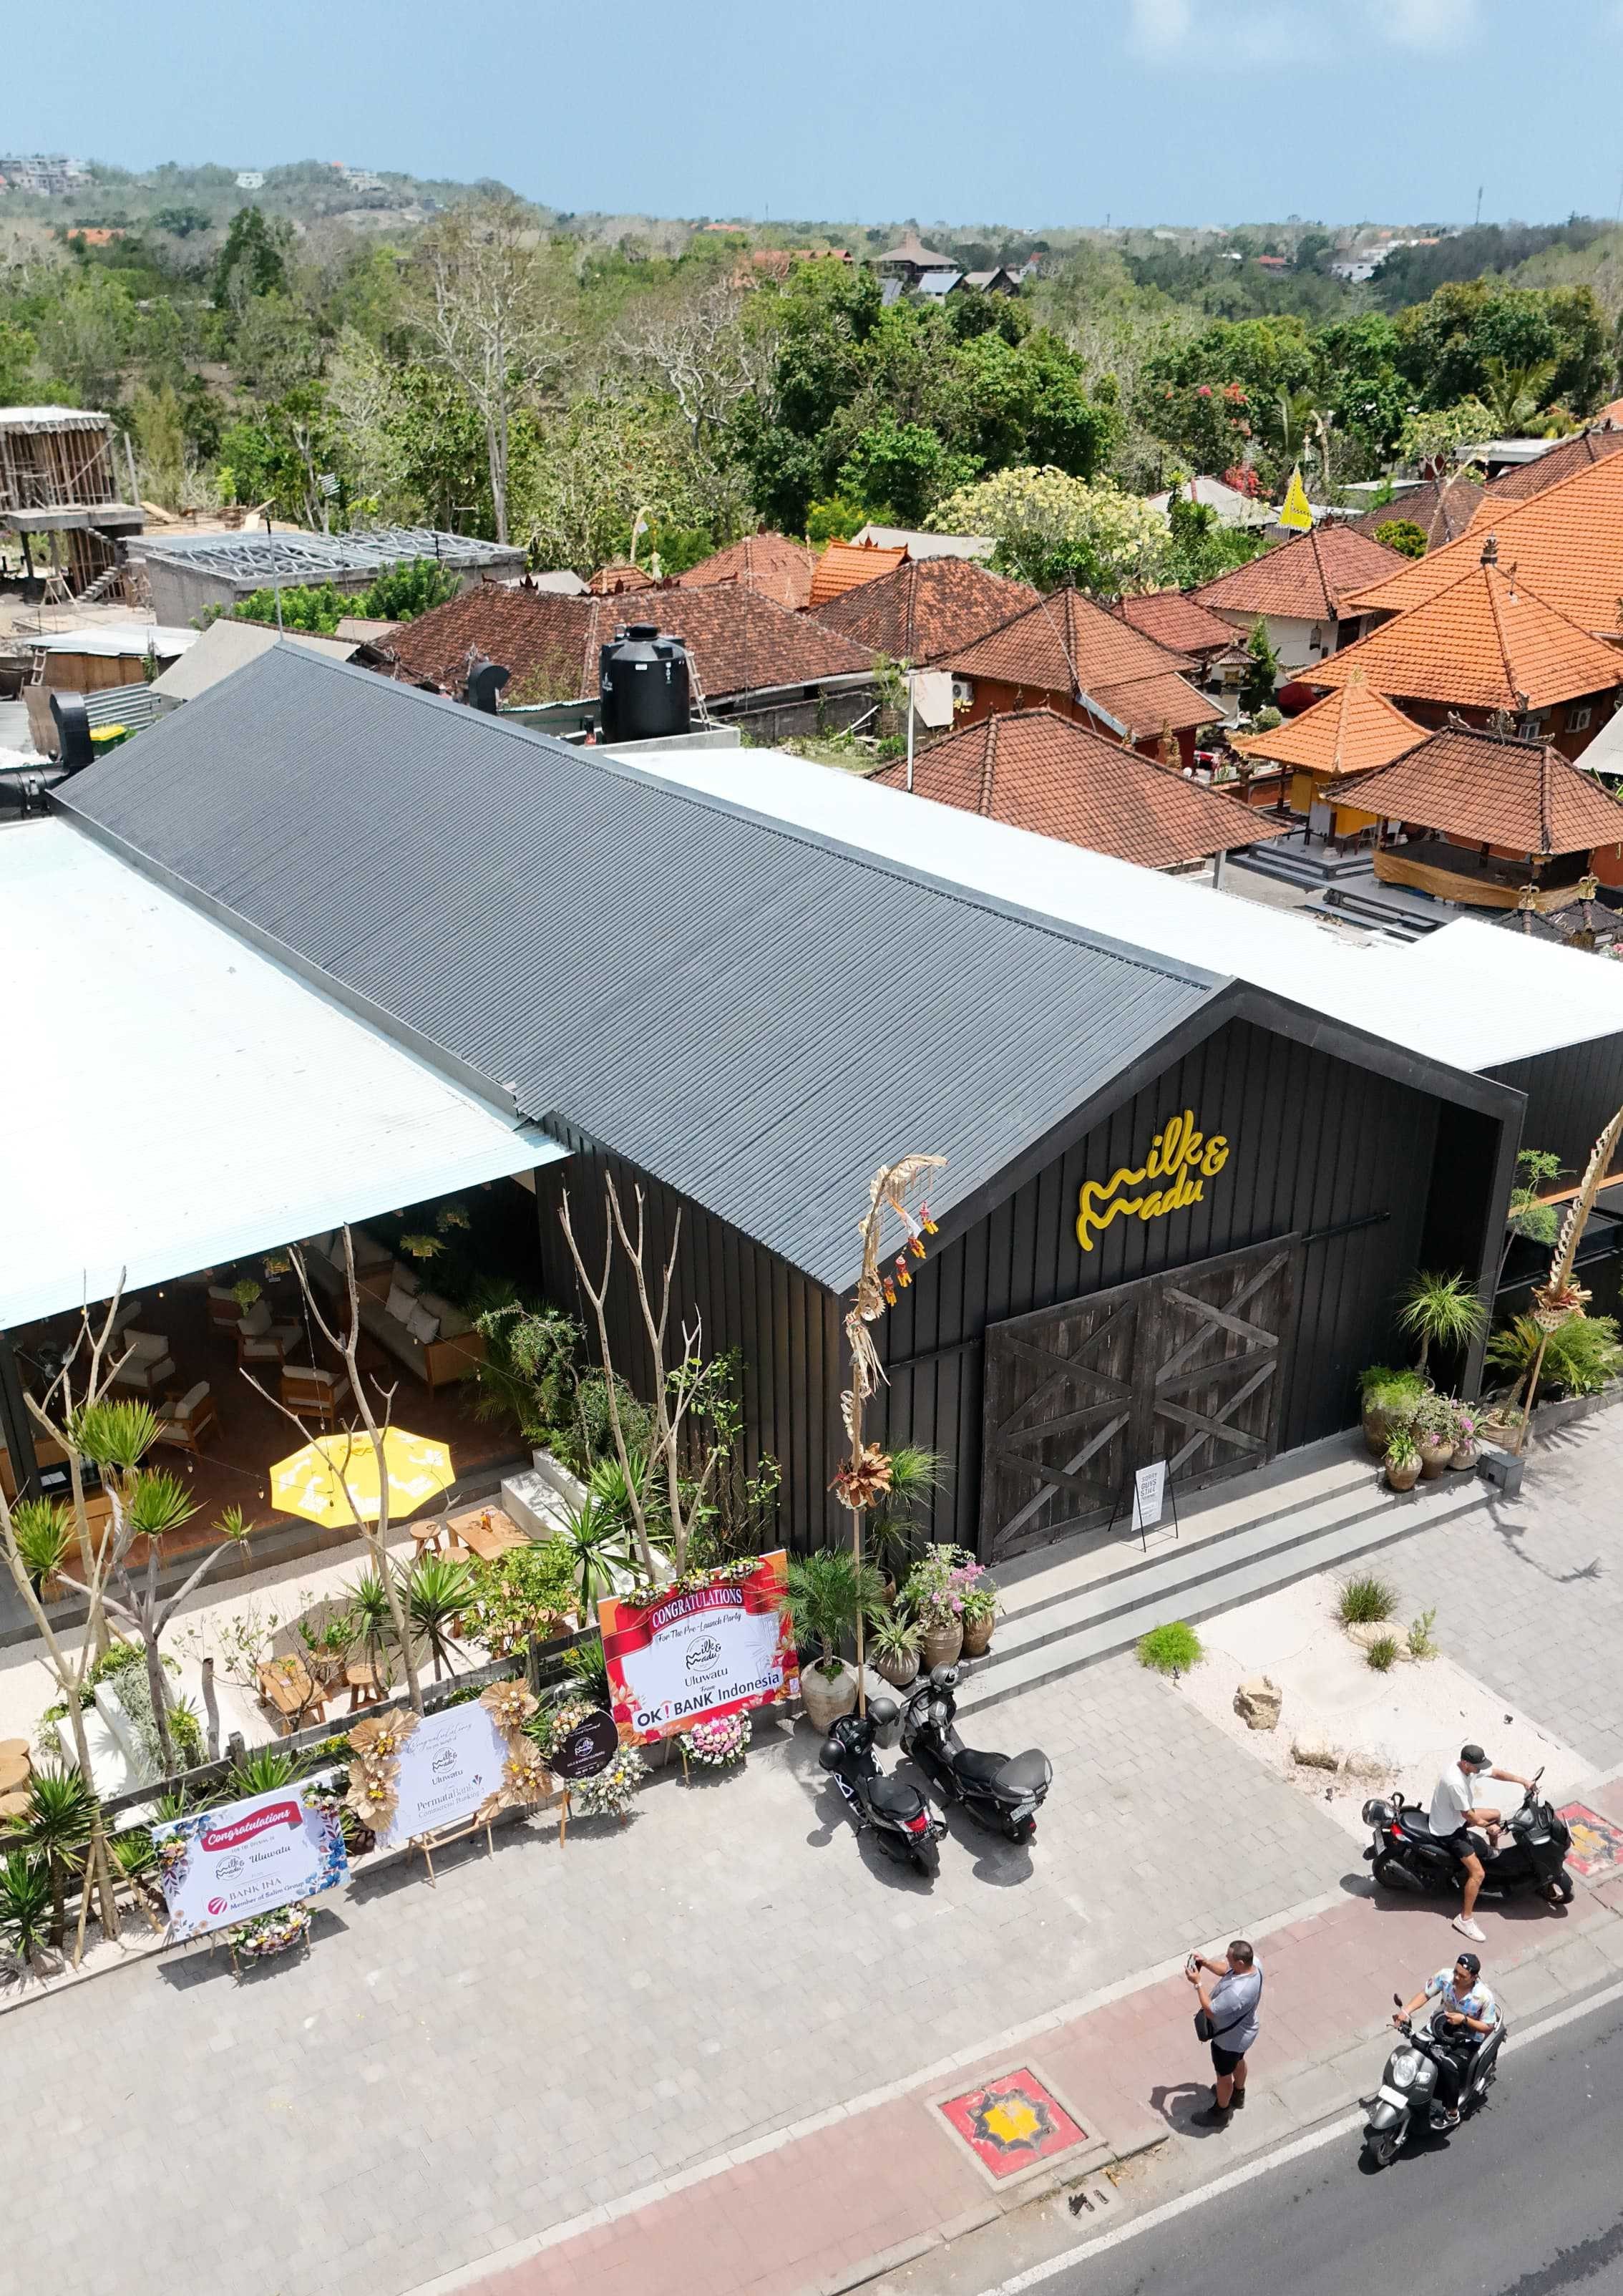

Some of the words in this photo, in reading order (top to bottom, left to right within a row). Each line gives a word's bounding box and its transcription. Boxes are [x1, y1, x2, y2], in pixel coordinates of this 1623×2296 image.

[653, 1589, 742, 1628] CONGRATULATIONS
[657, 1633, 670, 1643] For
[671, 1629, 682, 1638] The
[723, 1612, 741, 1623] Party
[685, 1668, 728, 1687] Uluwatu
[674, 1692, 713, 1716] BANK
[718, 1673, 779, 1701] Indonesia
[432, 1769, 463, 1785] Uluwatu
[208, 1809, 291, 1845] Congratulations
[249, 1846, 291, 1862] Uluwatu
[230, 1886, 259, 1900] BANK
[262, 1877, 281, 1889] INA
[230, 1898, 256, 1910] Member
